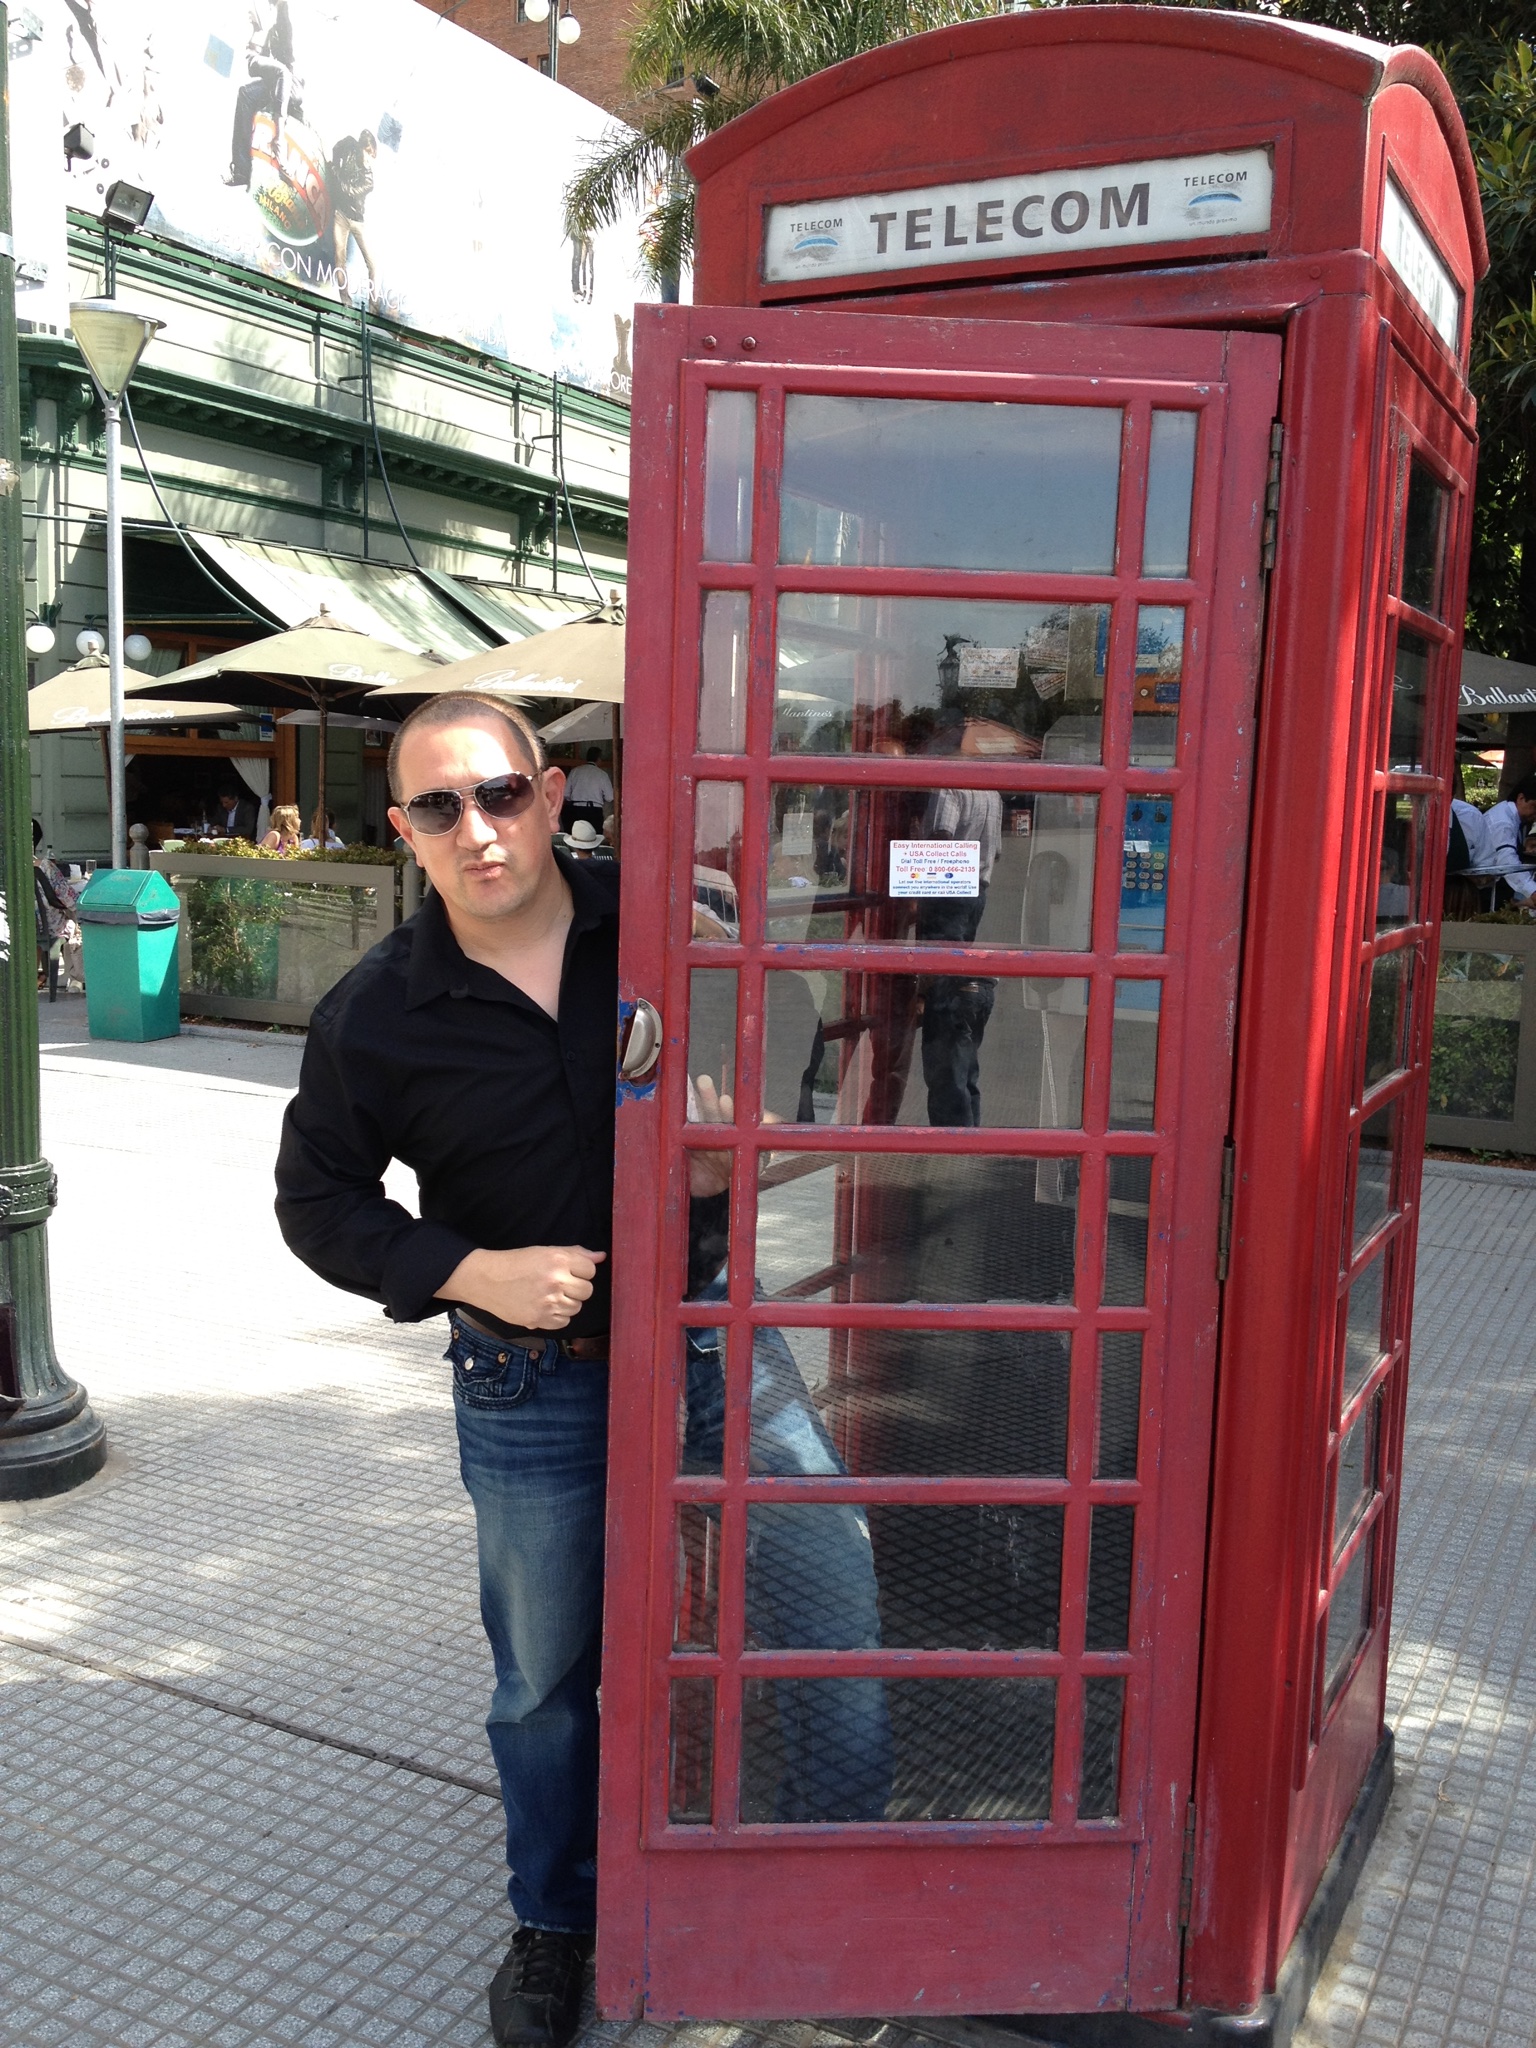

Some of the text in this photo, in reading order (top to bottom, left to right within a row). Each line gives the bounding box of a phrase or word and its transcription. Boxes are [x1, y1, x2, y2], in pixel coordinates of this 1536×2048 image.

[1184, 171, 1248, 187] TELECOM
[258, 192, 292, 230] MILANO
[870, 182, 1151, 254] TELECOM
[790, 218, 843, 232] TELECOM
[268, 242, 311, 279] CON
[893, 842, 909, 850] Easy
[954, 842, 978, 850] Calling
